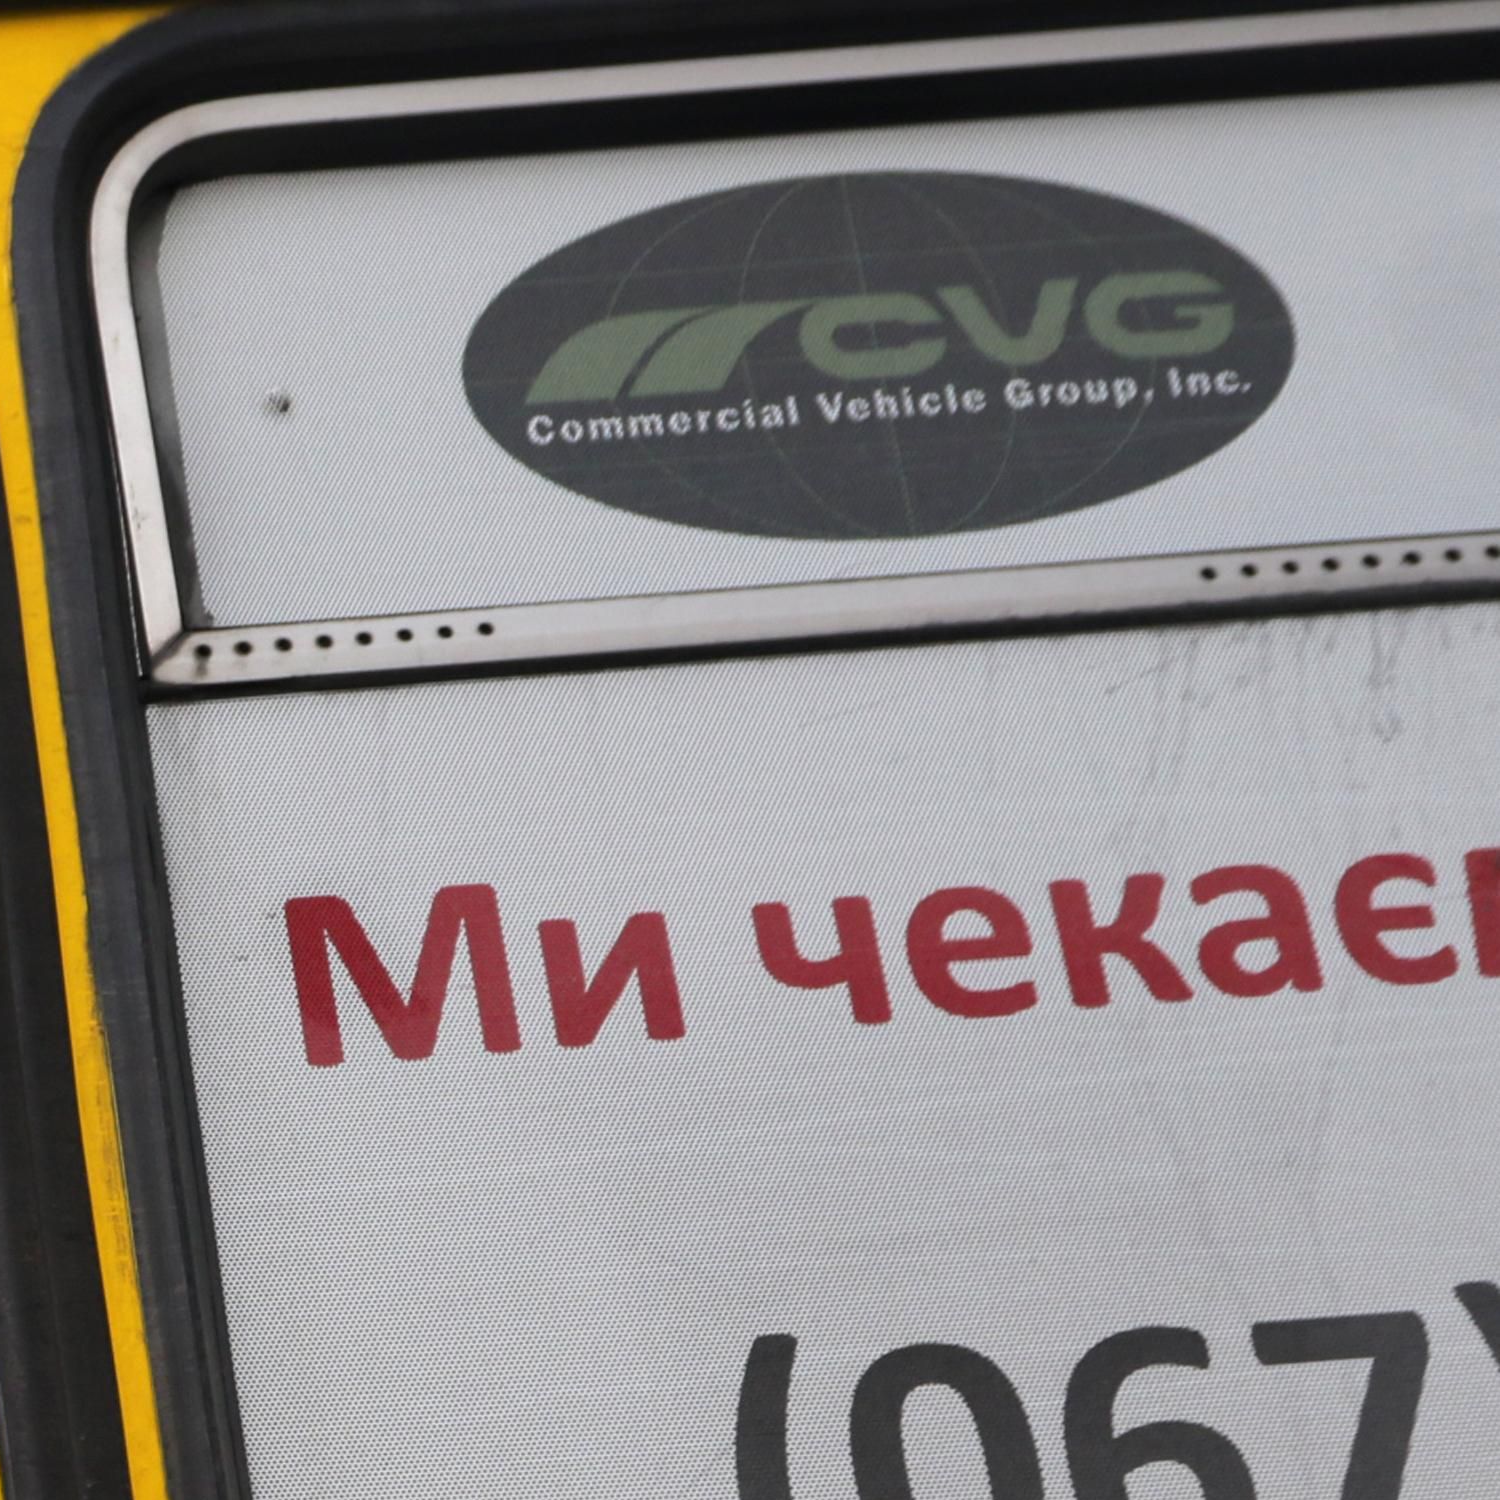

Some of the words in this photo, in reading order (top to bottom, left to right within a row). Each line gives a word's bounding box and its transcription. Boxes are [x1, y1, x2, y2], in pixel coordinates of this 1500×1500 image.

[799, 270, 1236, 381] CVG
[525, 396, 800, 446] Commercial
[815, 383, 988, 424] Vehicle
[1003, 377, 1155, 410] Group,
[1166, 366, 1252, 399] Inc.
[283, 882, 686, 1067] Ми
[750, 847, 1500, 1025] чекає
